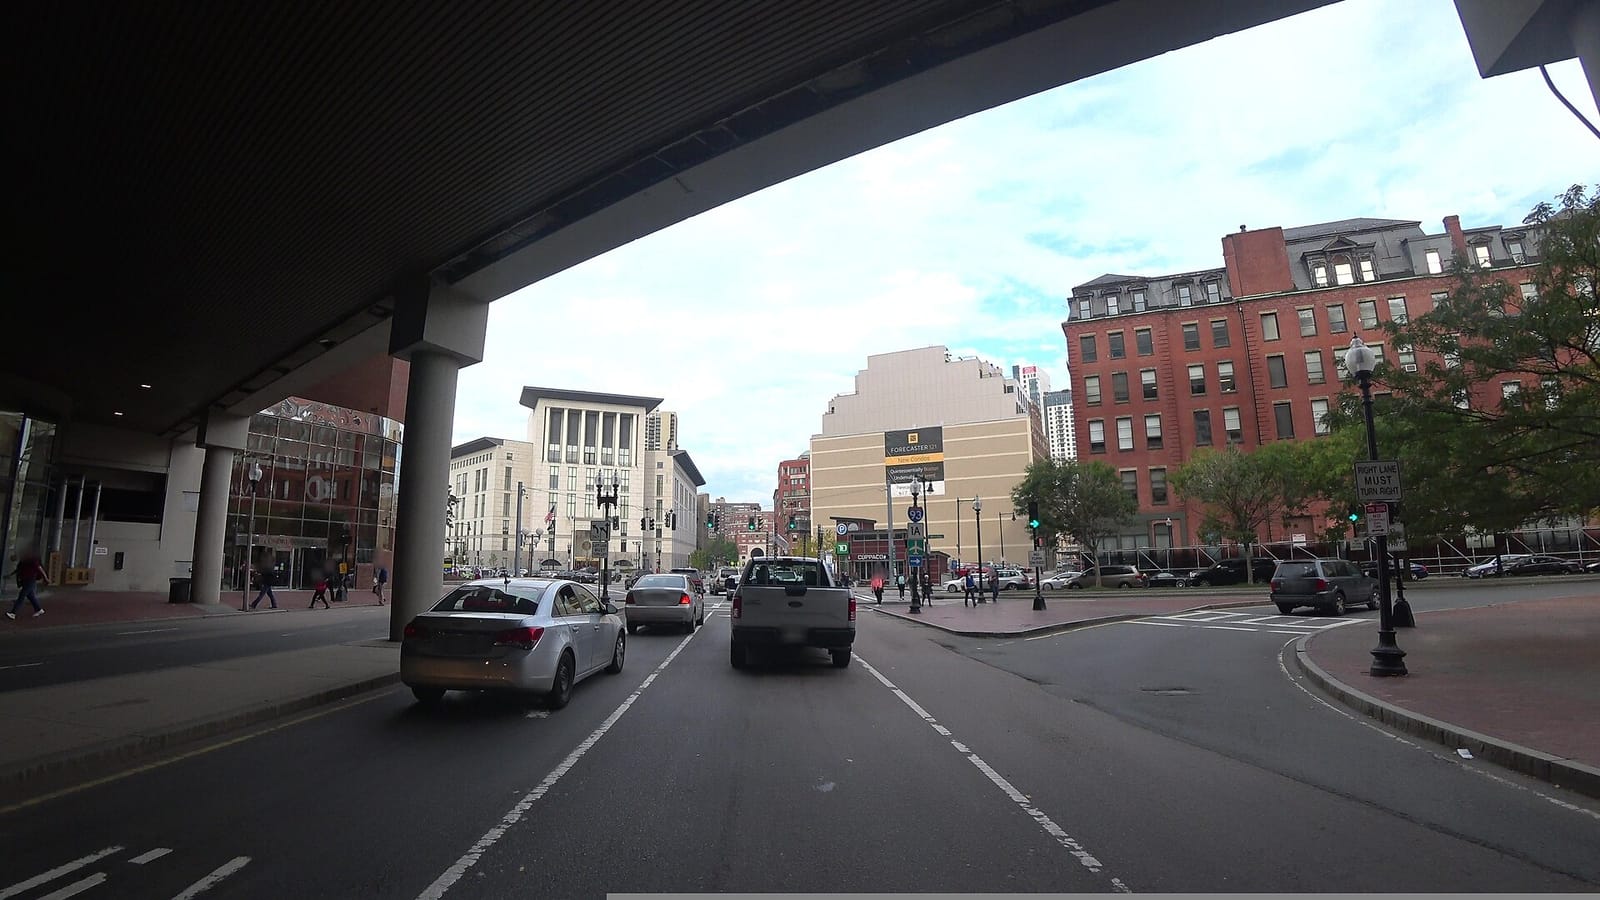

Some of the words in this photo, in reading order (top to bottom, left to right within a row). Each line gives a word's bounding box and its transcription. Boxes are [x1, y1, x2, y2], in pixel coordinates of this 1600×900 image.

[890, 444, 928, 453] FORECASTER
[1357, 465, 1377, 474] RIGHT
[1379, 464, 1397, 473] LANE
[1364, 475, 1391, 485] MUST
[1360, 487, 1377, 496] TURN
[1379, 486, 1398, 495] RIGHT
[909, 510, 922, 520] 93
[910, 526, 921, 536] 1A
[838, 544, 848, 552] TD
